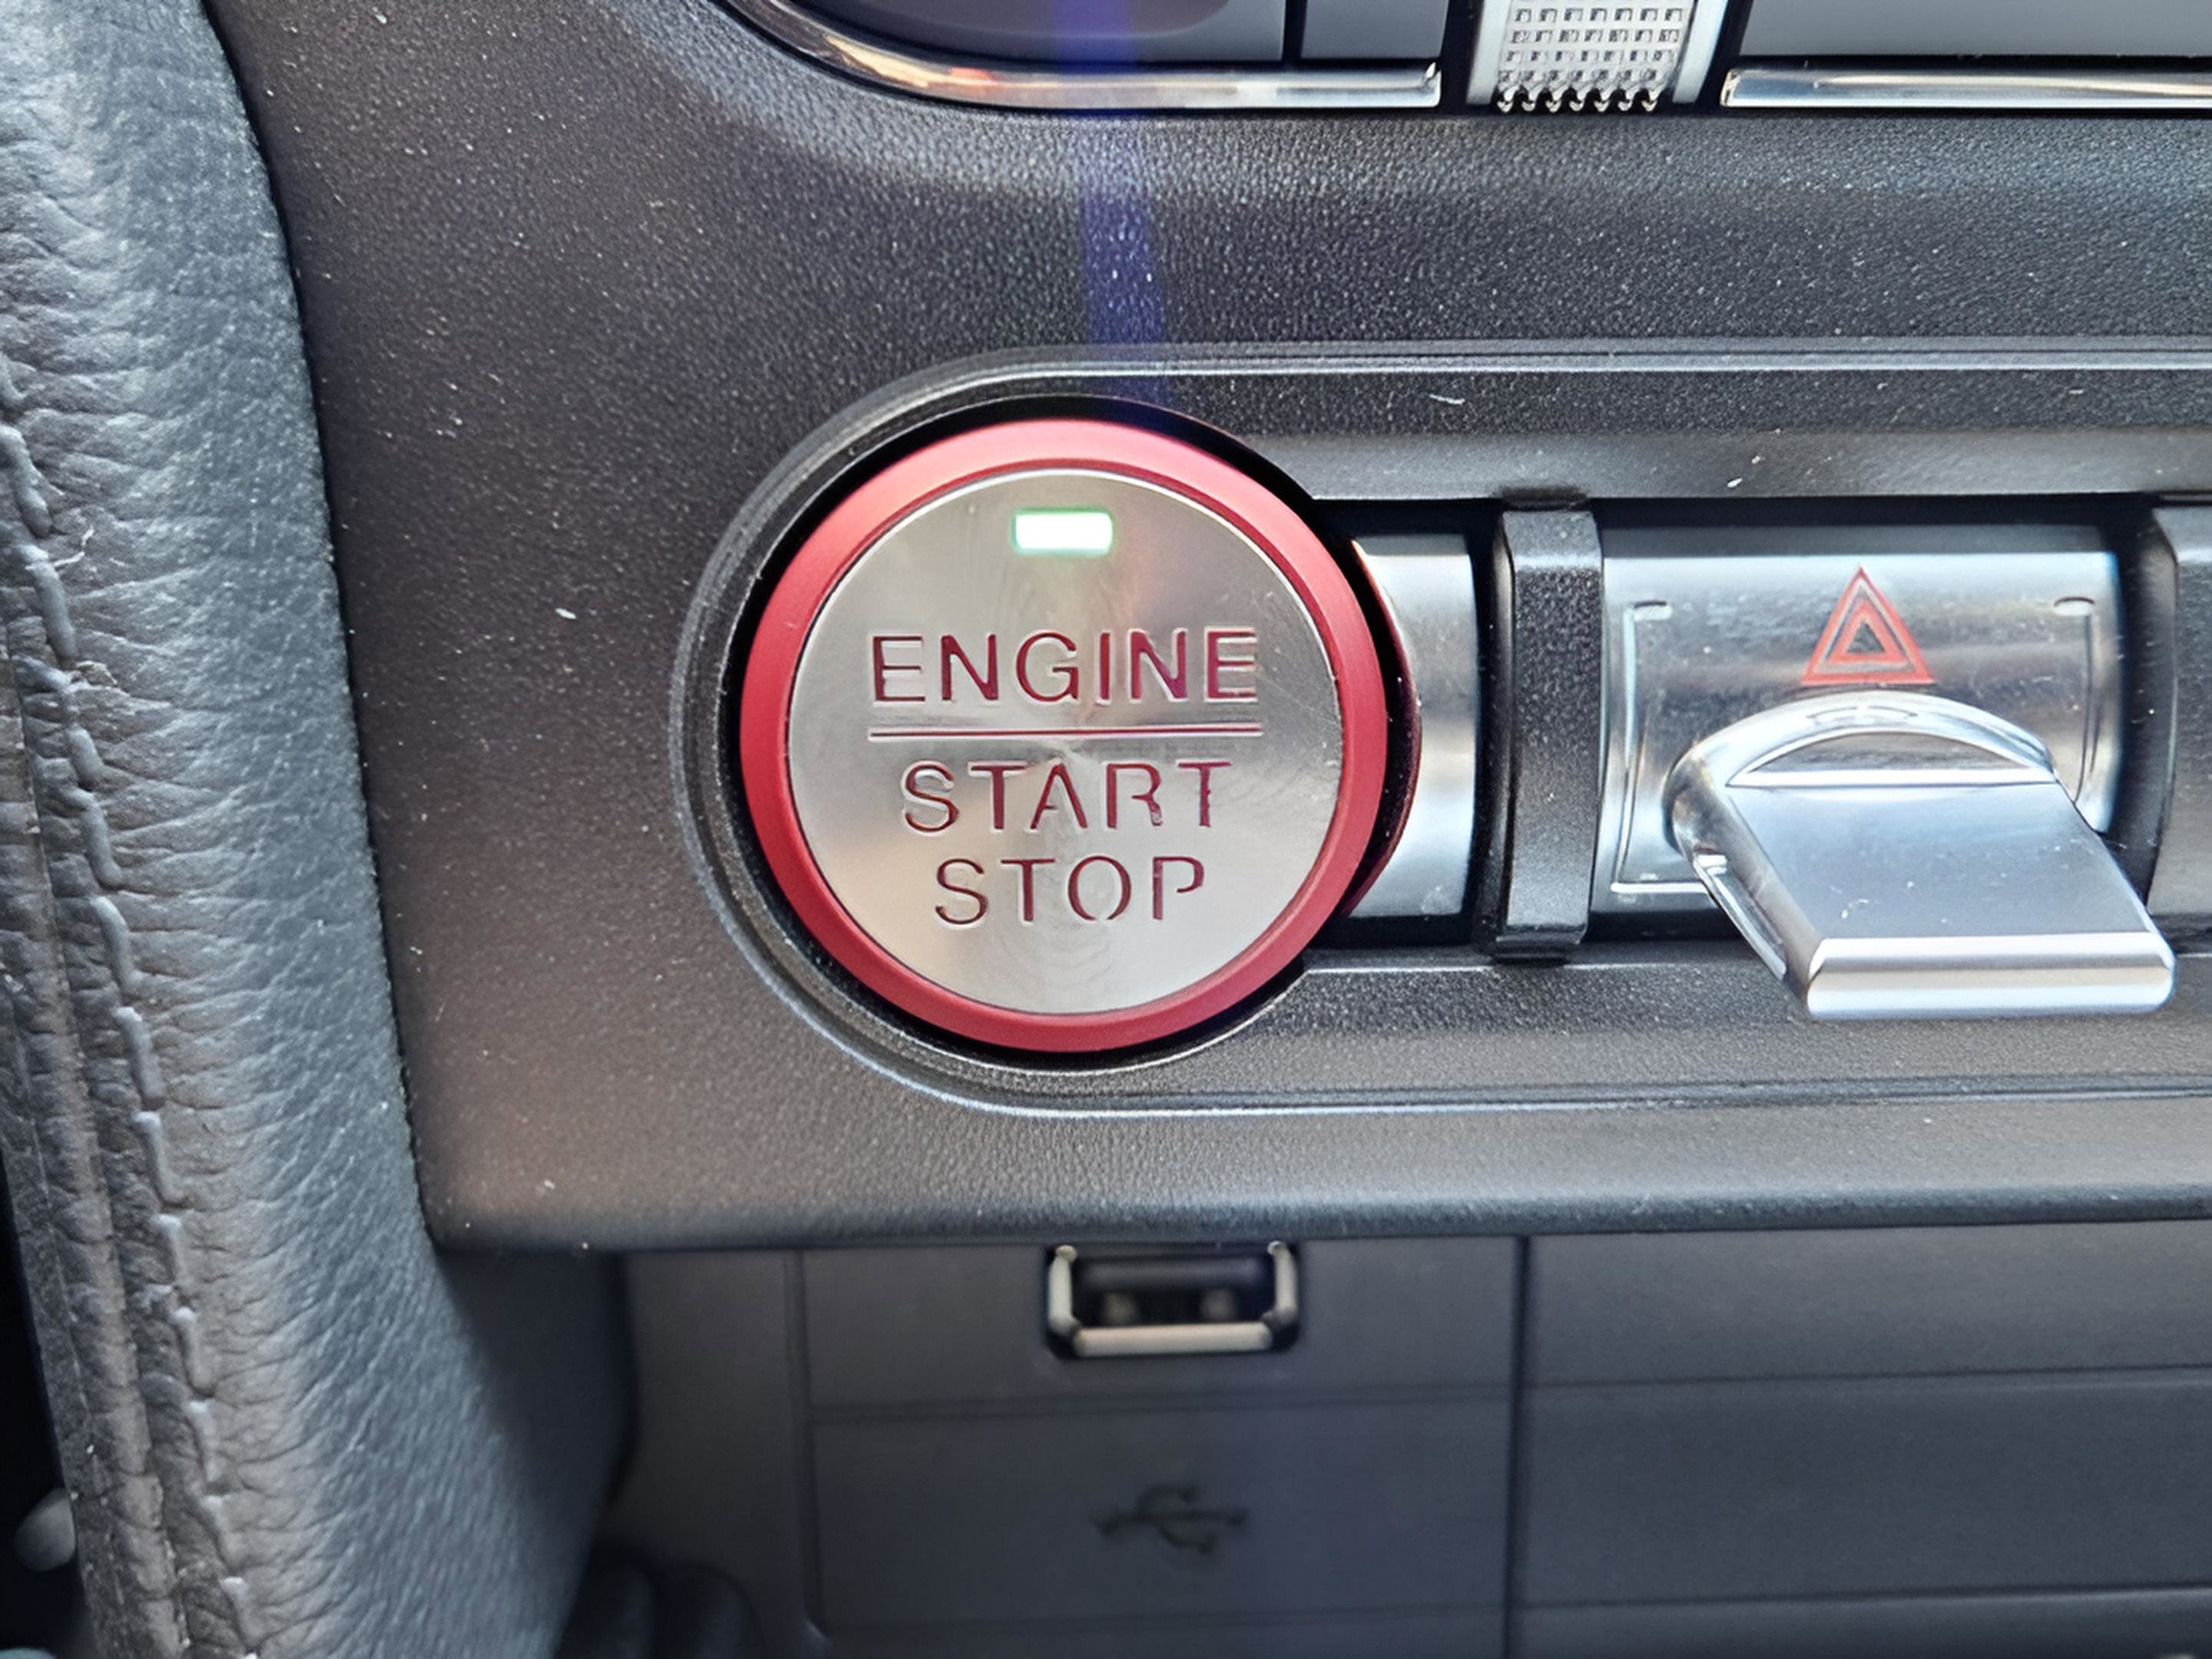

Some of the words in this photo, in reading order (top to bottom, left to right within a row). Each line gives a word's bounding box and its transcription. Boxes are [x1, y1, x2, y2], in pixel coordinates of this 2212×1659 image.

[872, 630, 1257, 704] ENGINE
[905, 761, 1230, 833] START
[935, 856, 1205, 926] STOP
